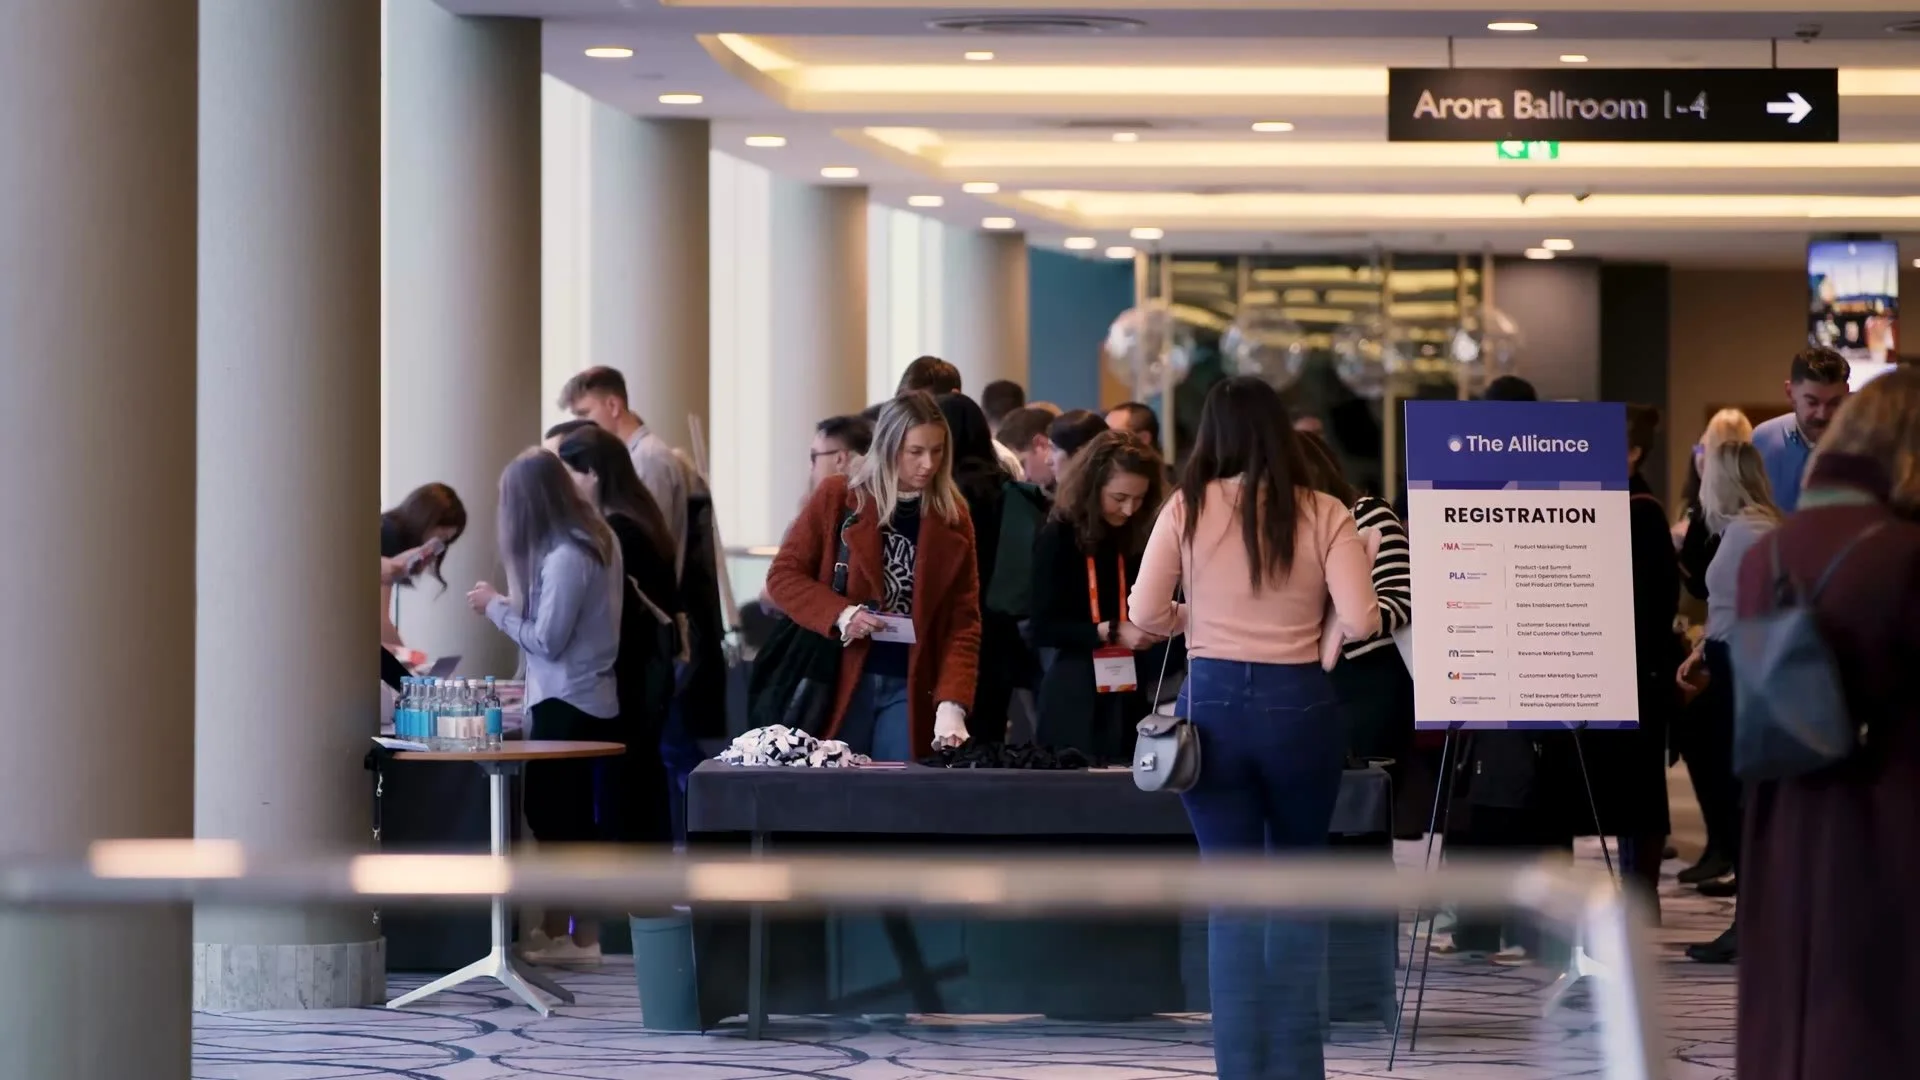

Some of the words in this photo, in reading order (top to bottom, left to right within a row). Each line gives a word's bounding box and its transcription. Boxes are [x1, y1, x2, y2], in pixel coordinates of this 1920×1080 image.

[1414, 90, 1503, 119] Arora
[1514, 90, 1647, 119] Ballroom
[1466, 435, 1503, 452] The
[1508, 435, 1588, 452] Alliance
[1445, 507, 1596, 523] REGISTRATION
[1542, 650, 1572, 658] Marketing
